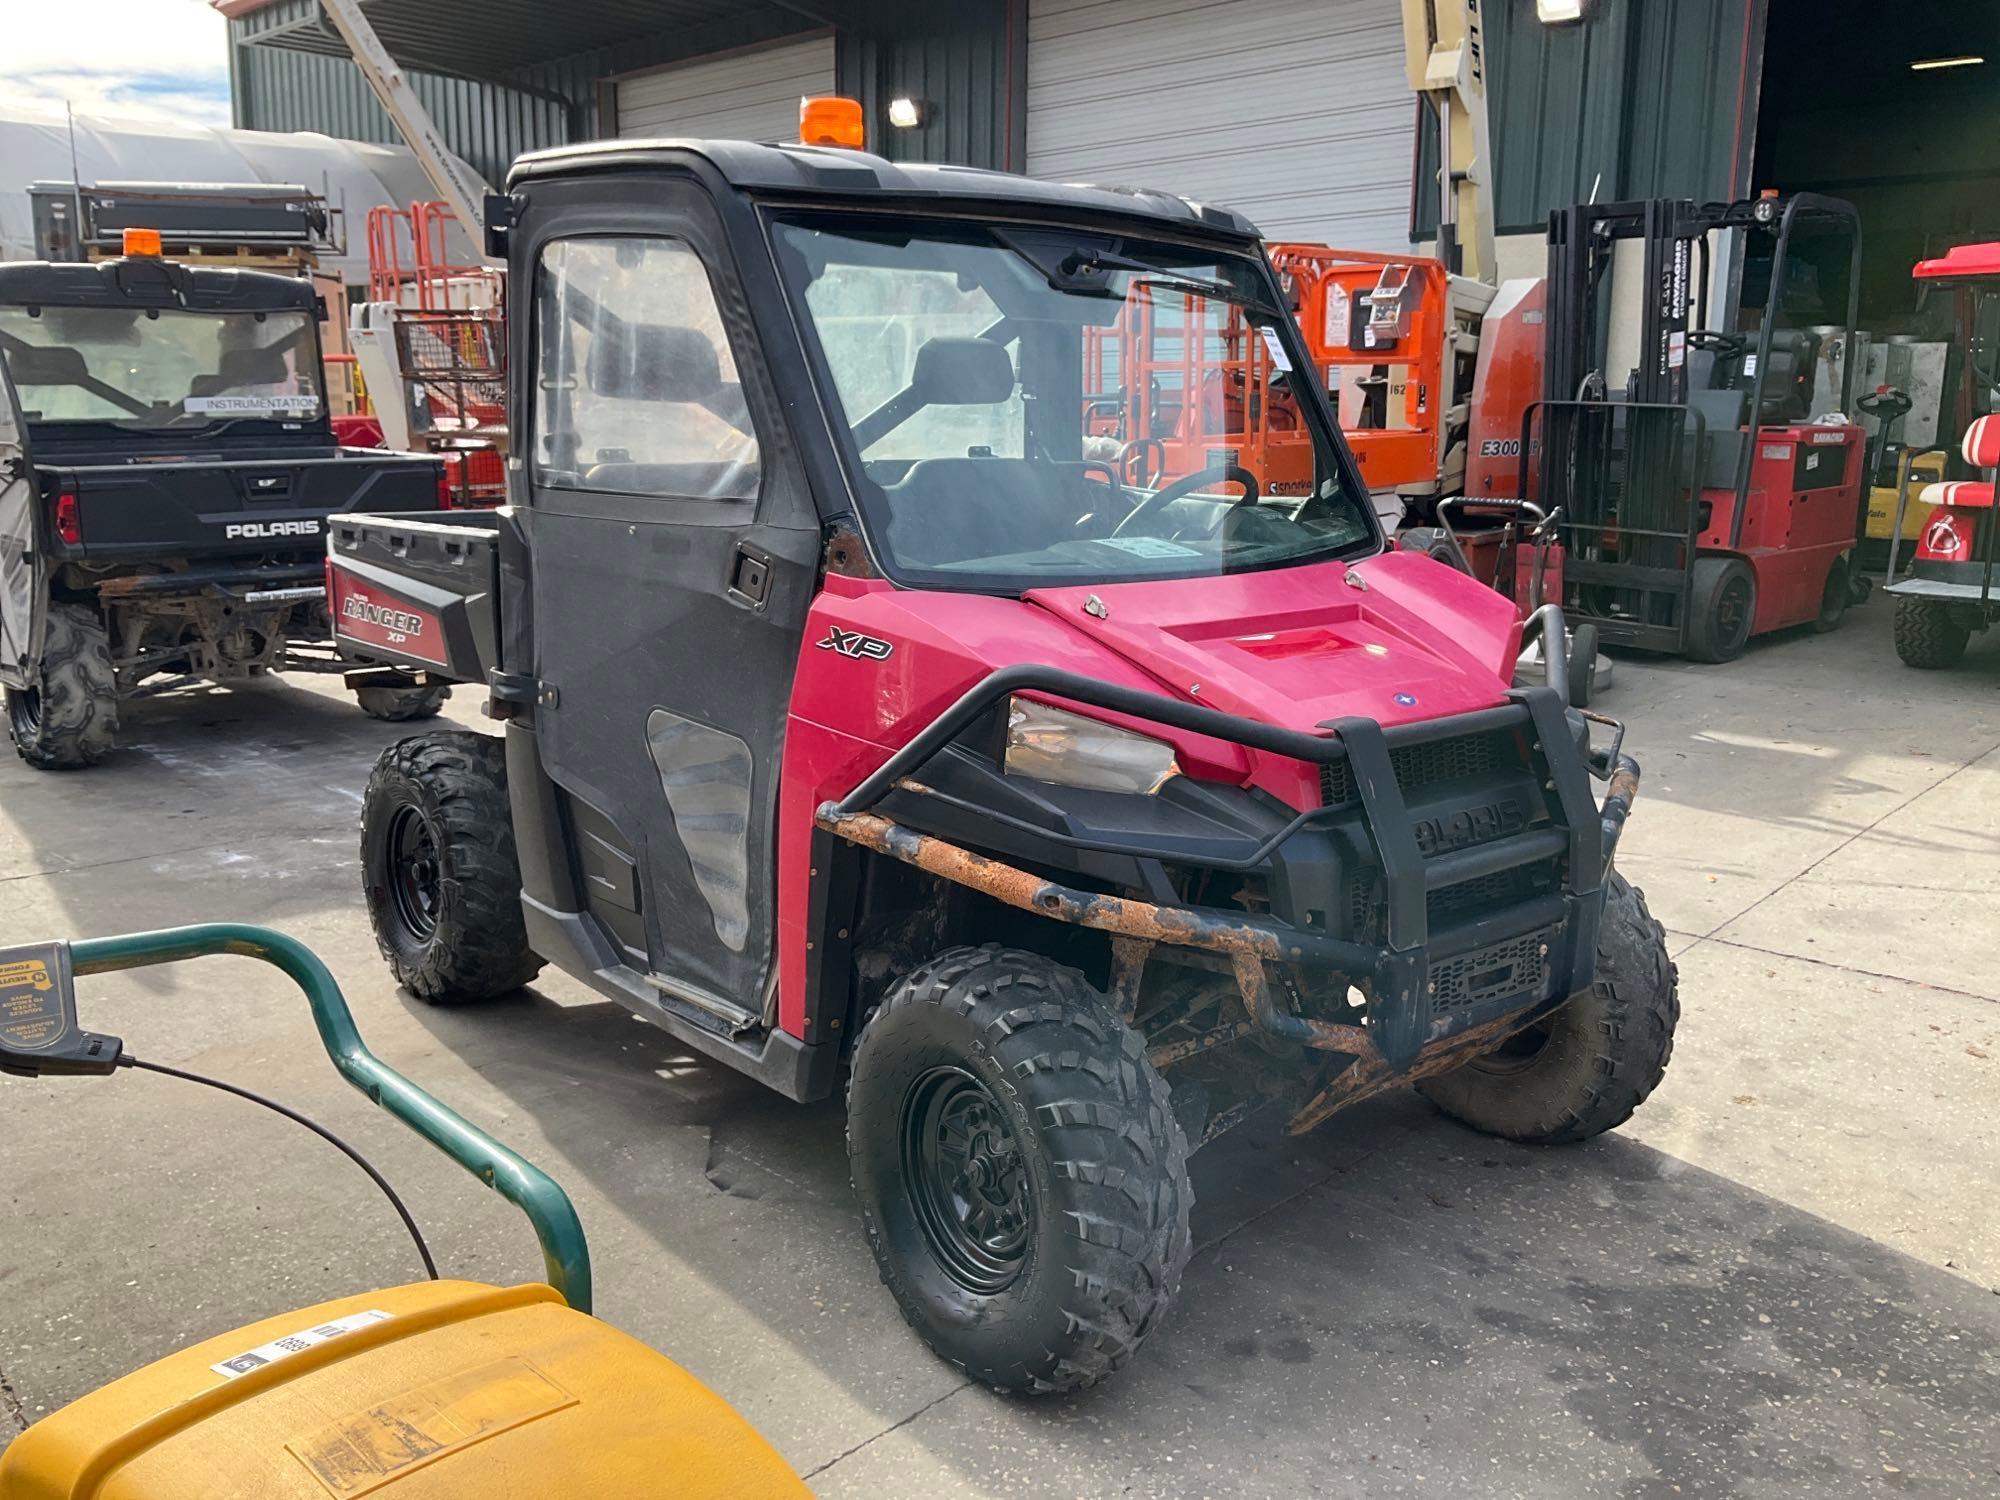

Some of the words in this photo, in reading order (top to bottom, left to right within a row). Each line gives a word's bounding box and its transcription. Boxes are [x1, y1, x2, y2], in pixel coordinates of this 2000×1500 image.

[1470, 25, 1482, 84] LIFT
[1672, 239, 1682, 319] RAYMOND
[207, 398, 318, 409] INSTRUMENTATION
[1390, 384, 1406, 395] 162
[226, 521, 320, 538] POLARIS
[342, 597, 423, 636] RANGER
[387, 631, 407, 643] XP
[816, 625, 893, 660] XP
[1415, 799, 1524, 854] OLARIS
